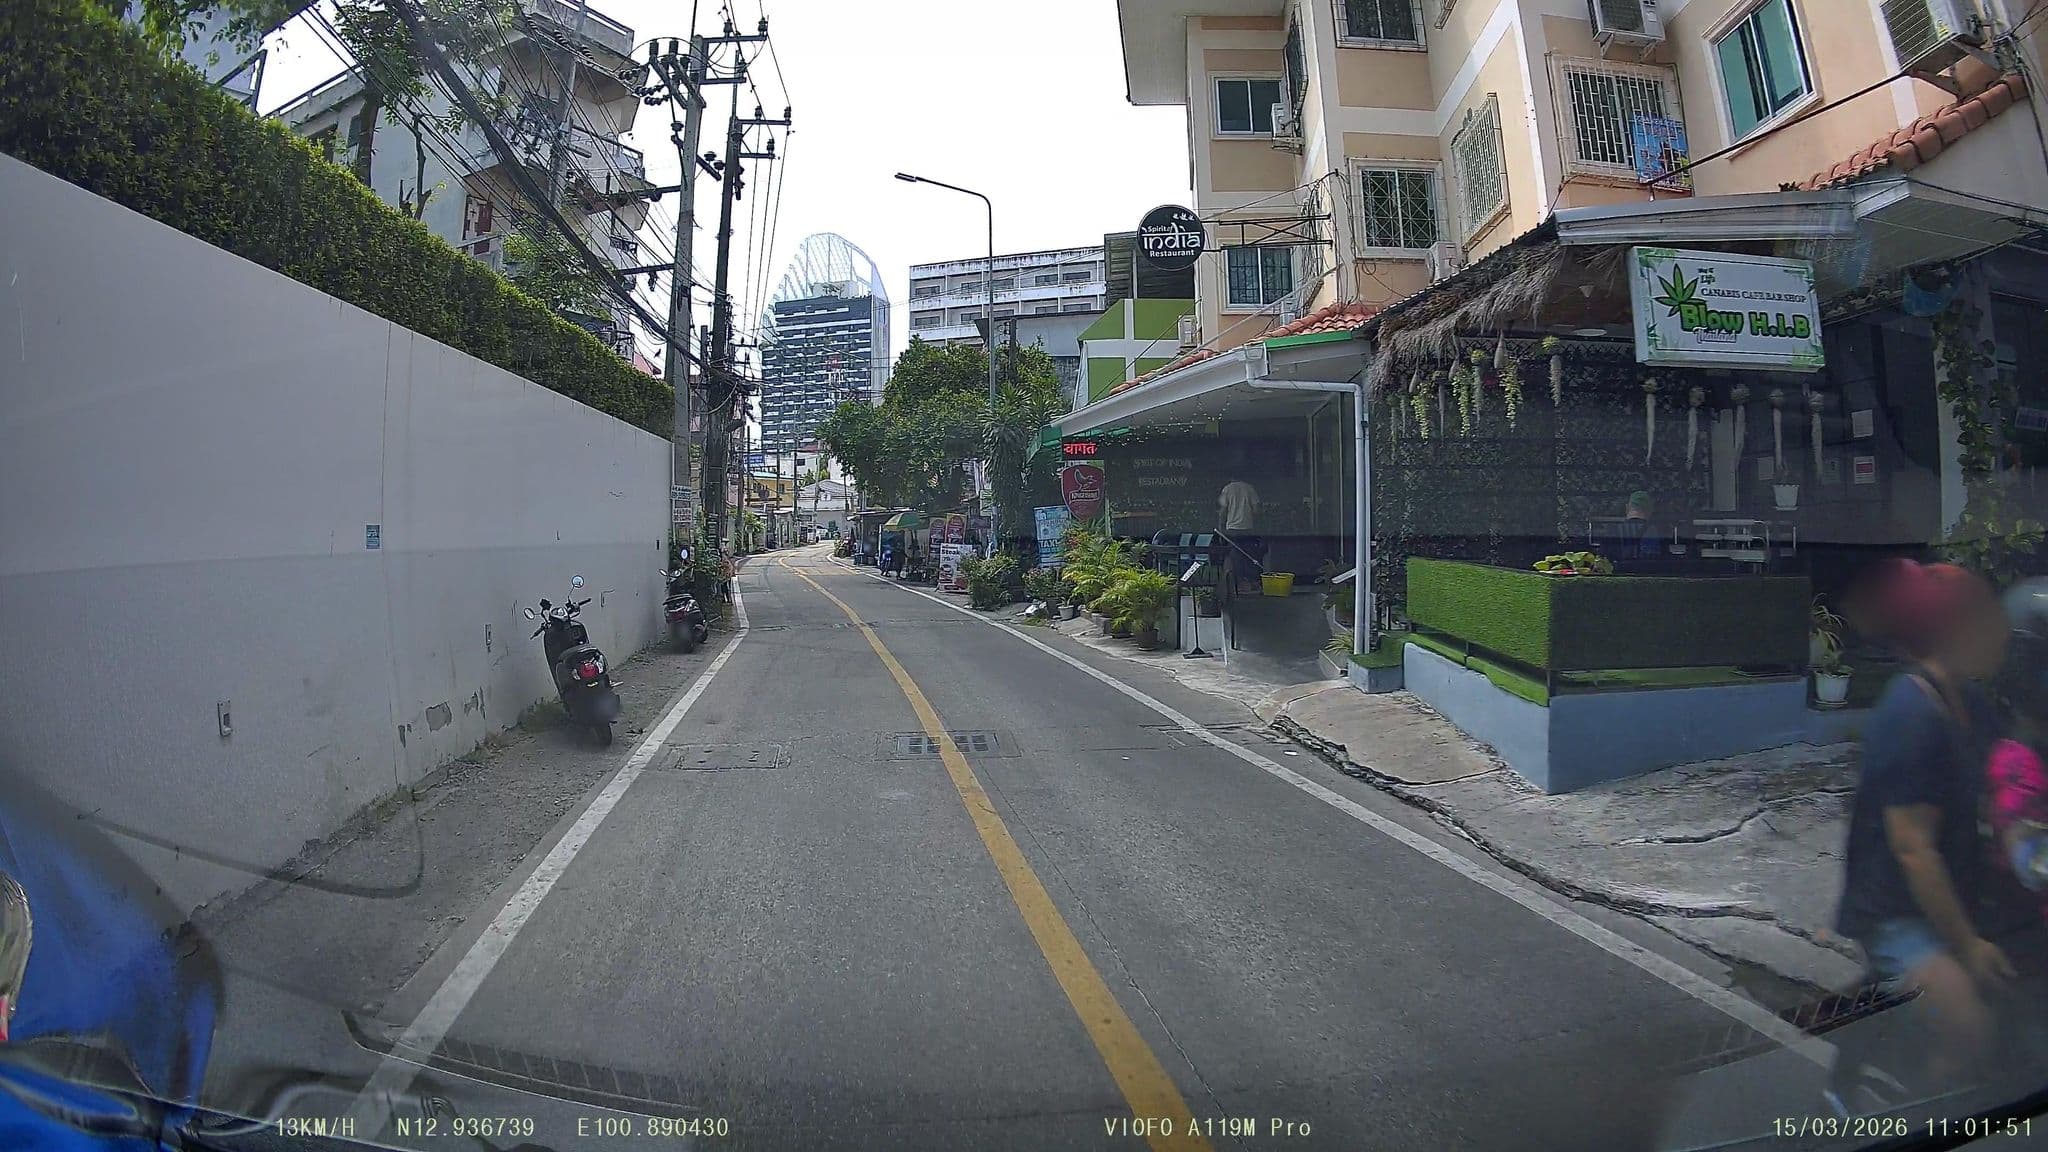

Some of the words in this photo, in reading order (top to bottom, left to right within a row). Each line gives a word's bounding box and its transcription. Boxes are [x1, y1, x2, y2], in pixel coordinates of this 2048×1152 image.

[1147, 225, 1167, 233] Spirit
[1149, 250, 1195, 258] Restaurant
[1766, 292, 1784, 301] BAR
[1784, 293, 1807, 303] SHOP
[1679, 301, 1744, 333] Blow
[1749, 311, 1811, 339] H.I.B
[1693, 326, 1737, 344] Thailand
